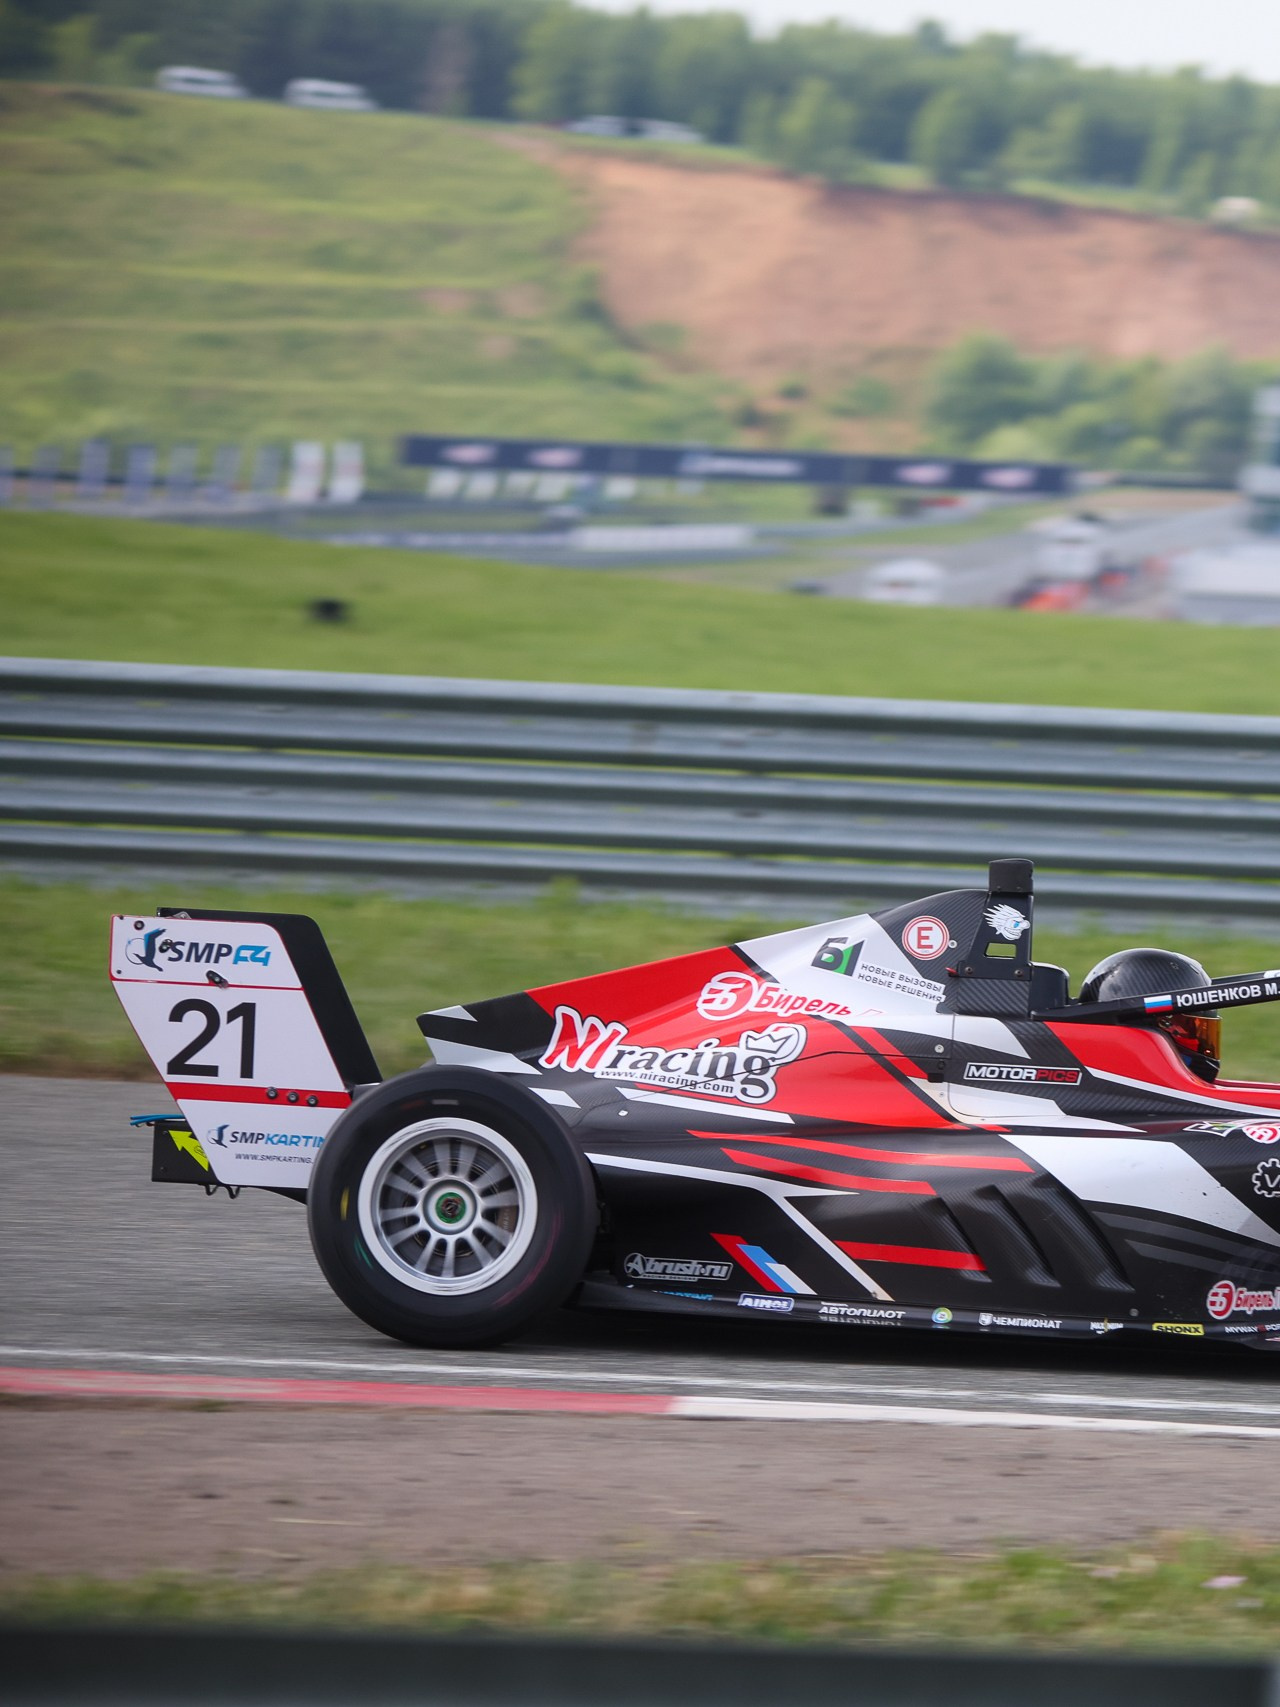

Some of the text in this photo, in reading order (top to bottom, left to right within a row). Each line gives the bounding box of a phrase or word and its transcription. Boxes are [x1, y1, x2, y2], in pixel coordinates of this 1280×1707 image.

[858, 973, 942, 1002] НОВЫЕ РЕШЕНИЯ
[860, 963, 942, 993] НОВЫЕ ВЫЗОВЫ
[754, 986, 852, 1016] Бирель
[1176, 984, 1261, 1007] ЮШЕНКОВ
[166, 998, 256, 1079] 21
[600, 1070, 734, 1094] www.niracing.com
[967, 1065, 1078, 1083] MOTORPICS
[235, 1153, 314, 1165] WWW.SMPKARTING.
[818, 1306, 906, 1319] АВТОПИЛОТ
[992, 1316, 1062, 1329] ЧЕМПИОНАТ
